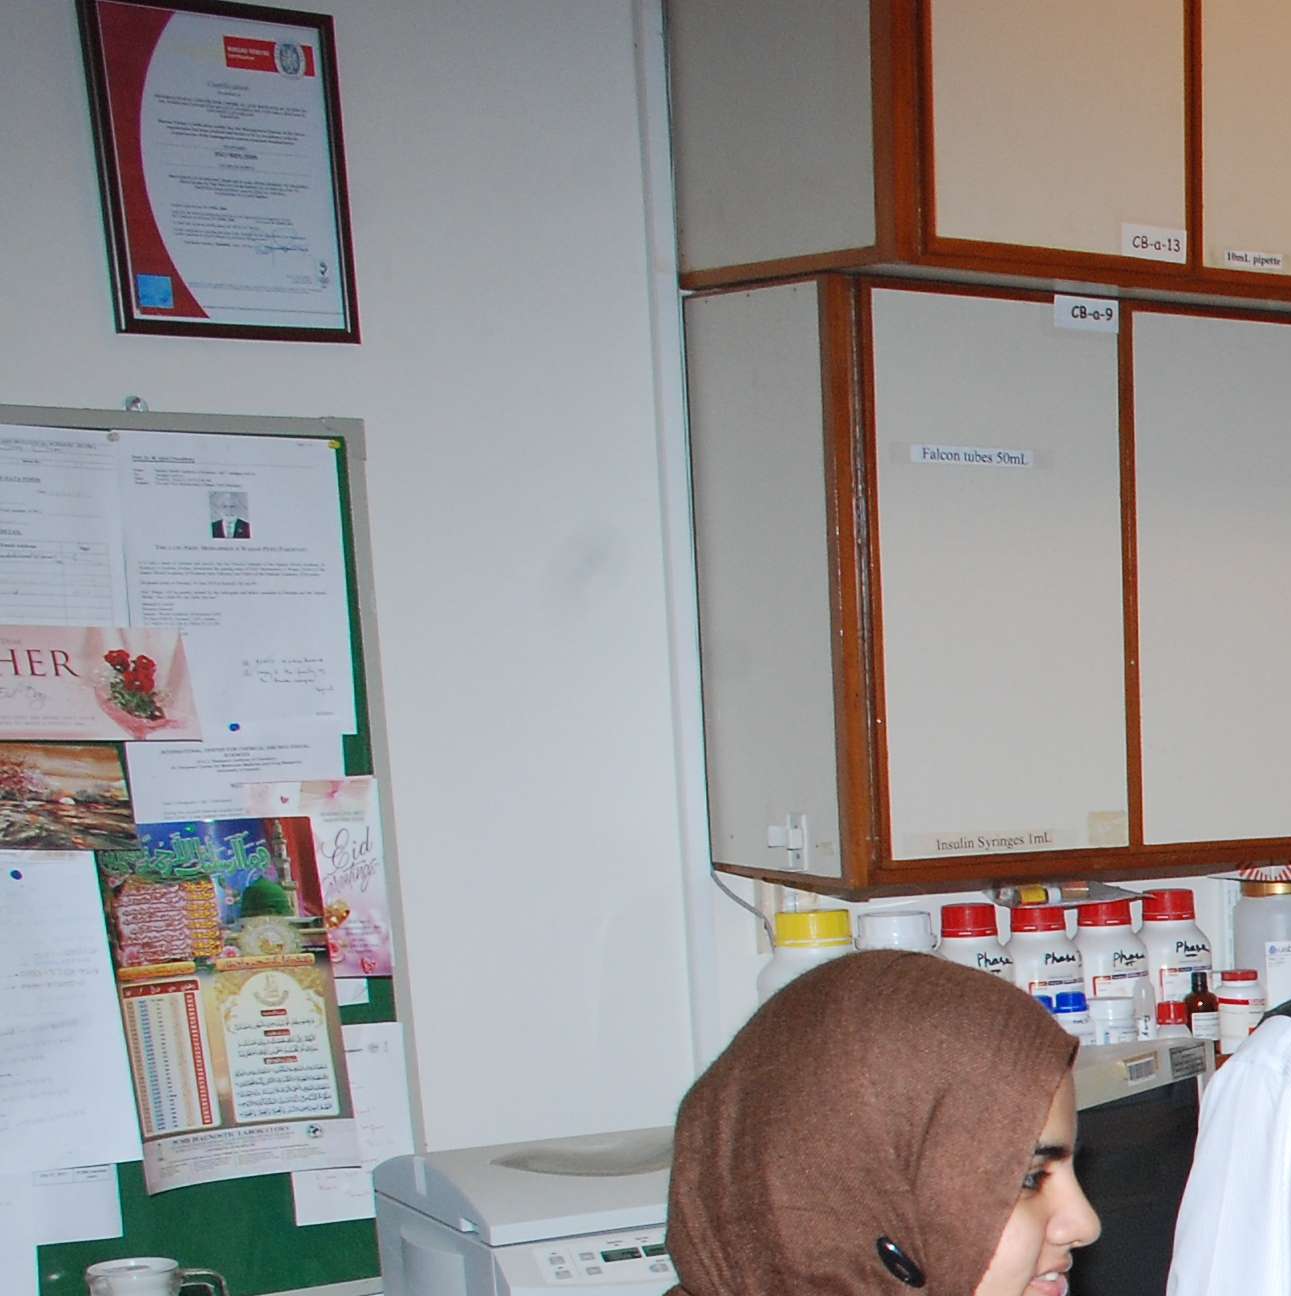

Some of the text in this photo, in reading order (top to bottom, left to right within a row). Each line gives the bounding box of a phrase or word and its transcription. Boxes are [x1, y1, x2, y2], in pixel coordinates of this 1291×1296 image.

[1132, 236, 1181, 252] CB-a-13
[1252, 255, 1280, 266] pipette
[1071, 306, 1113, 320] CB-a-9
[922, 448, 1027, 465] Falcon tubes 50mL
[937, 832, 1052, 851] Insulin Syringes 1mL
[1176, 941, 1209, 952] Phase
[977, 952, 1014, 966] Phase
[1045, 952, 1076, 965] Phase
[1113, 950, 1147, 967] Phase
